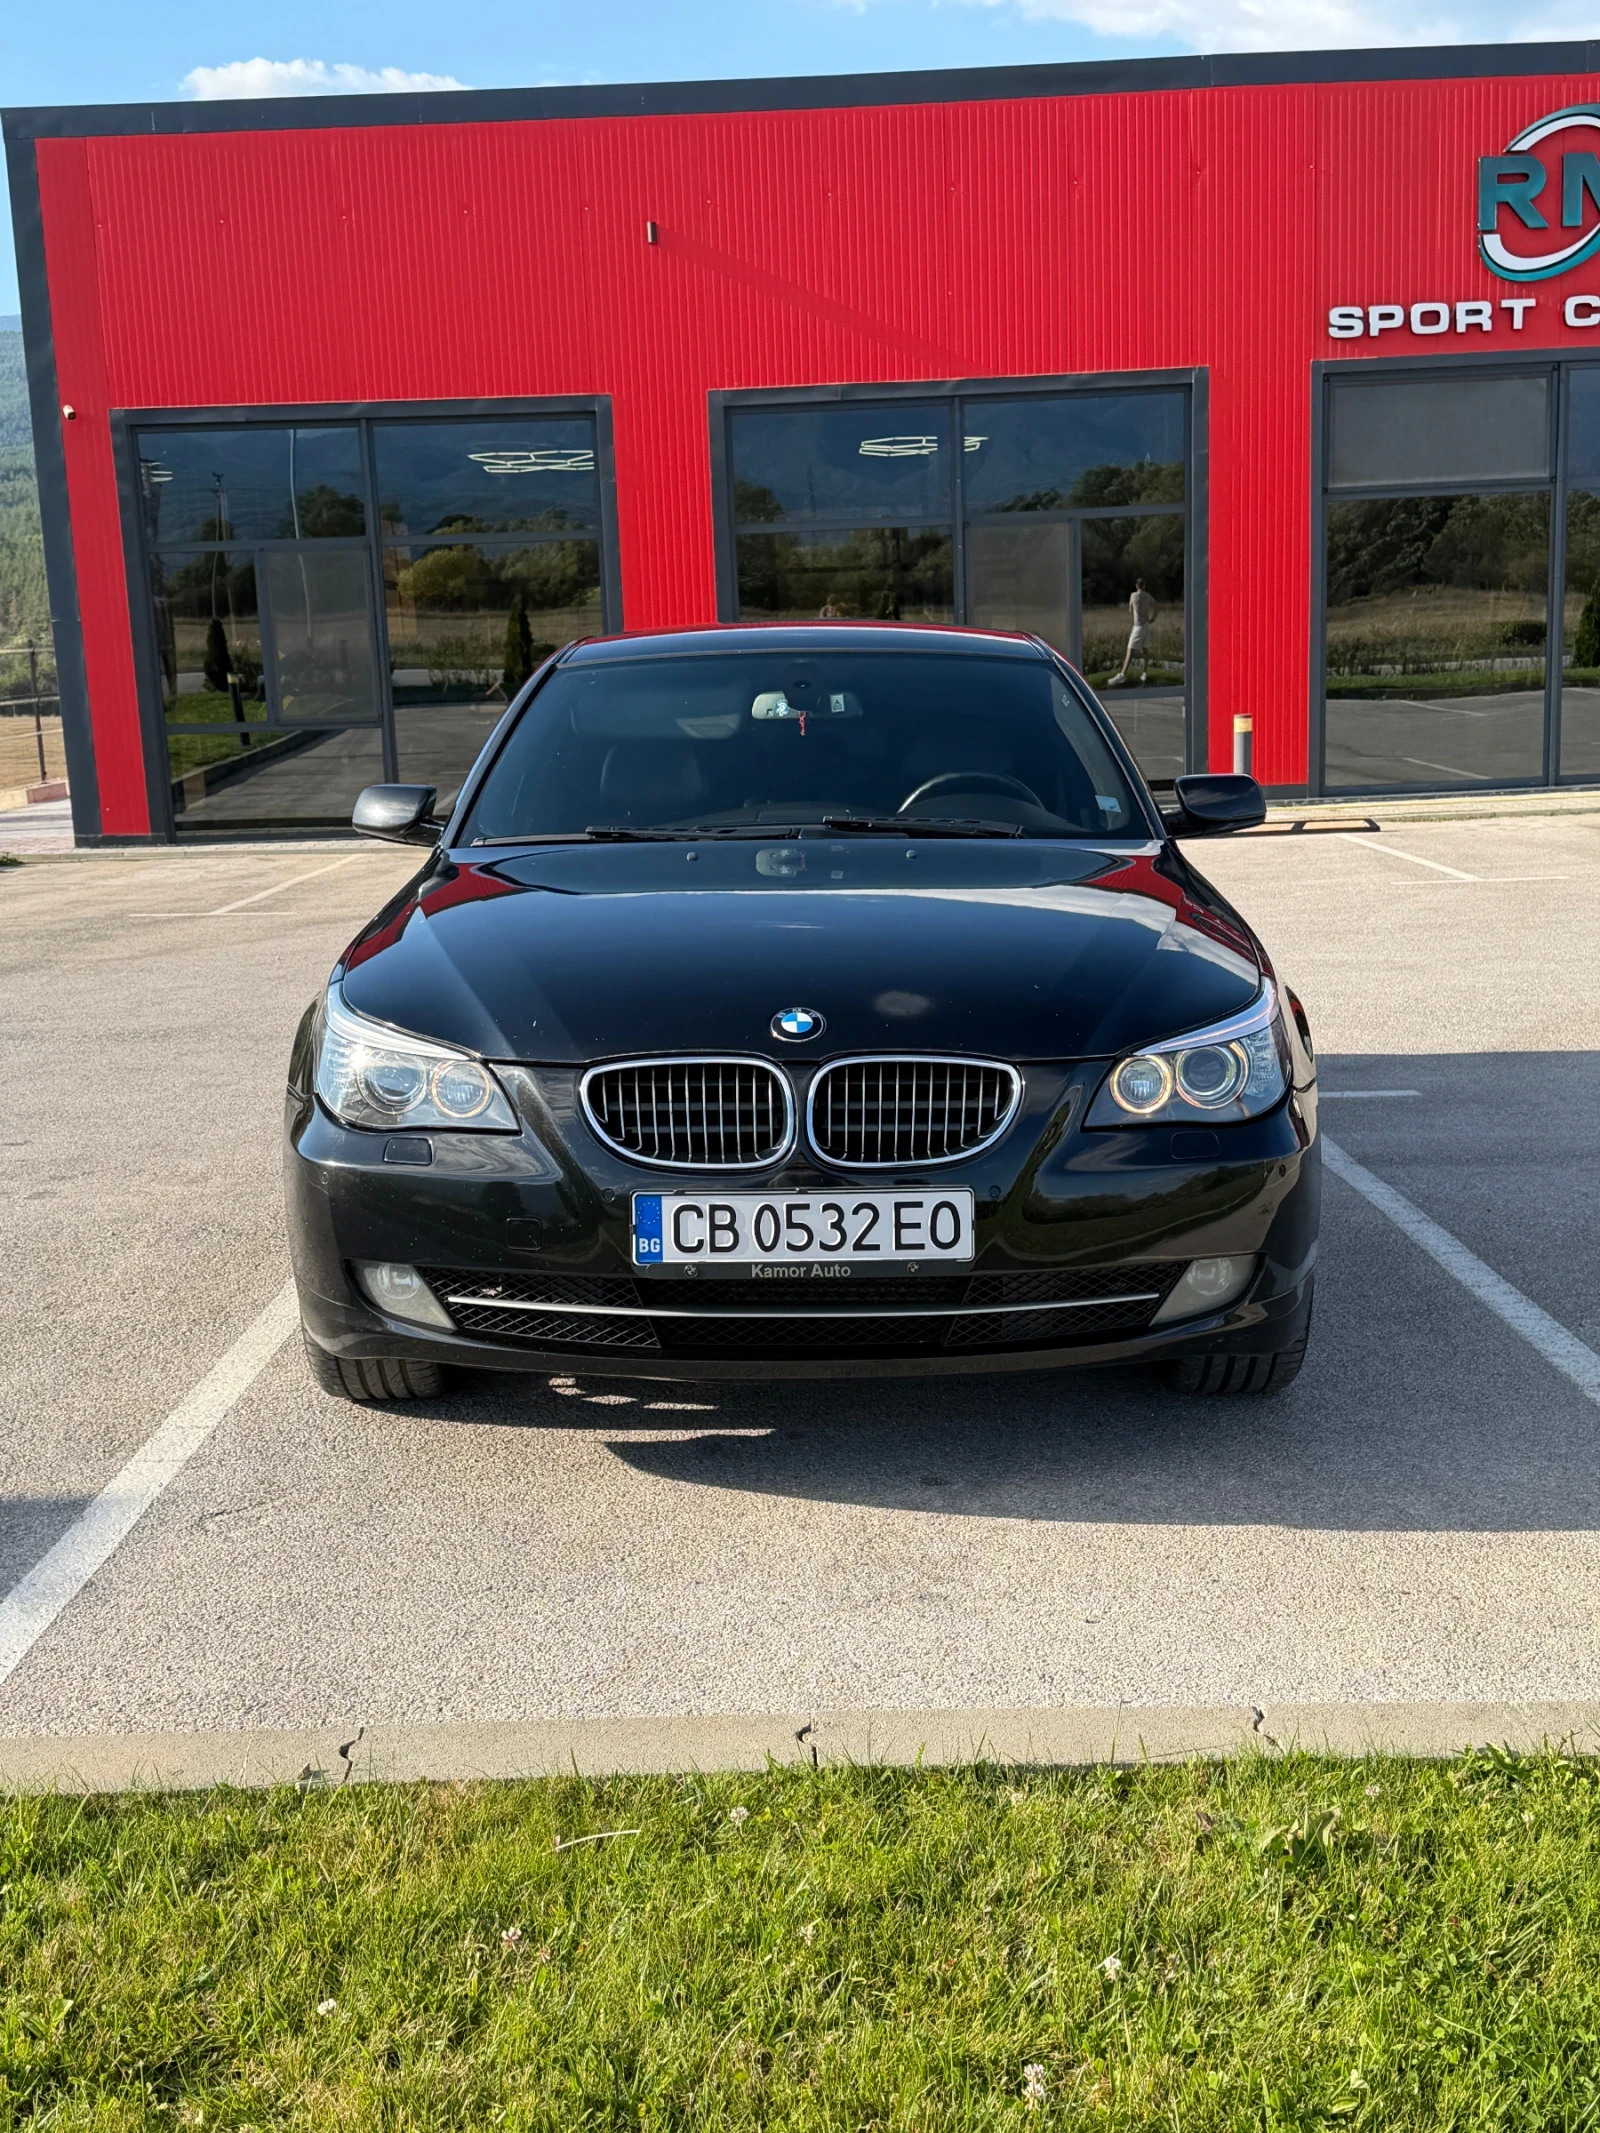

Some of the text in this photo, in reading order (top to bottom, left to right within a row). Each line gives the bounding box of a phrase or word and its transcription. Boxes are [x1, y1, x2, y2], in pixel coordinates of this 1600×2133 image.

[1328, 299, 1536, 338] SPORT
[672, 1203, 740, 1253] CB
[753, 1202, 881, 1252] 0532
[638, 1237, 661, 1254] BG
[751, 1264, 851, 1278] Kamor Auto
